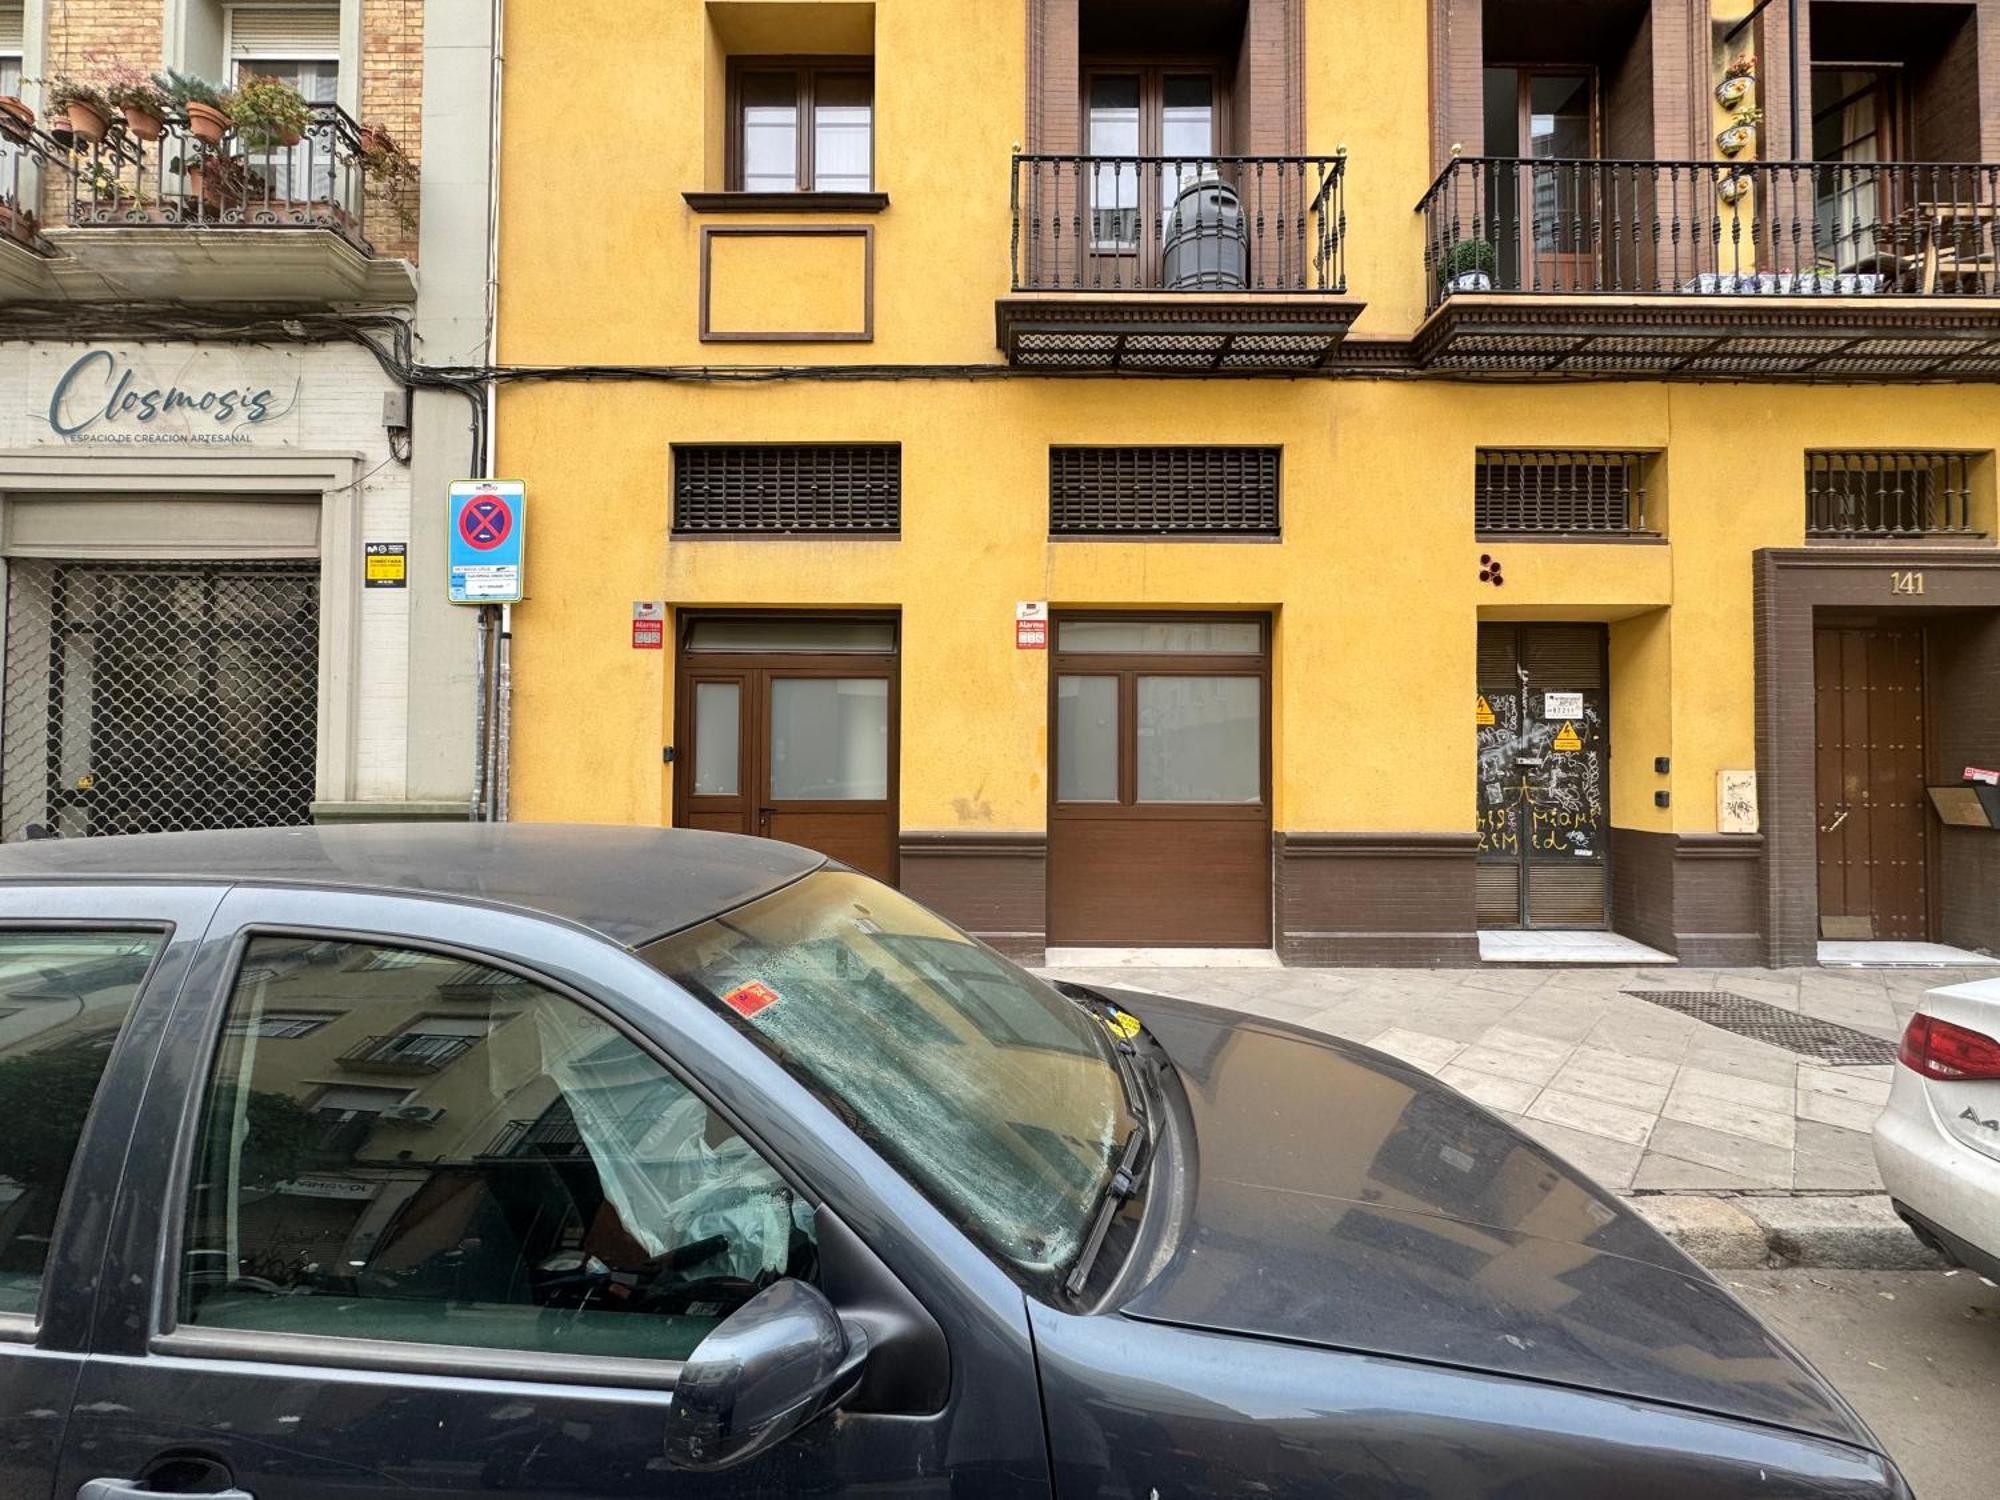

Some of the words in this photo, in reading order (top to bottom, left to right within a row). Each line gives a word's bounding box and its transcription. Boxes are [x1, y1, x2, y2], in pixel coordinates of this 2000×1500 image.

[50, 350, 271, 434] Closmosis
[70, 434, 115, 442] ESPACIO
[118, 434, 132, 442] DE
[191, 434, 252, 443] ARTESANAL
[1891, 572, 1925, 594] 141
[1019, 620, 1045, 628] Alarma
[1959, 1106, 1999, 1131] A4
